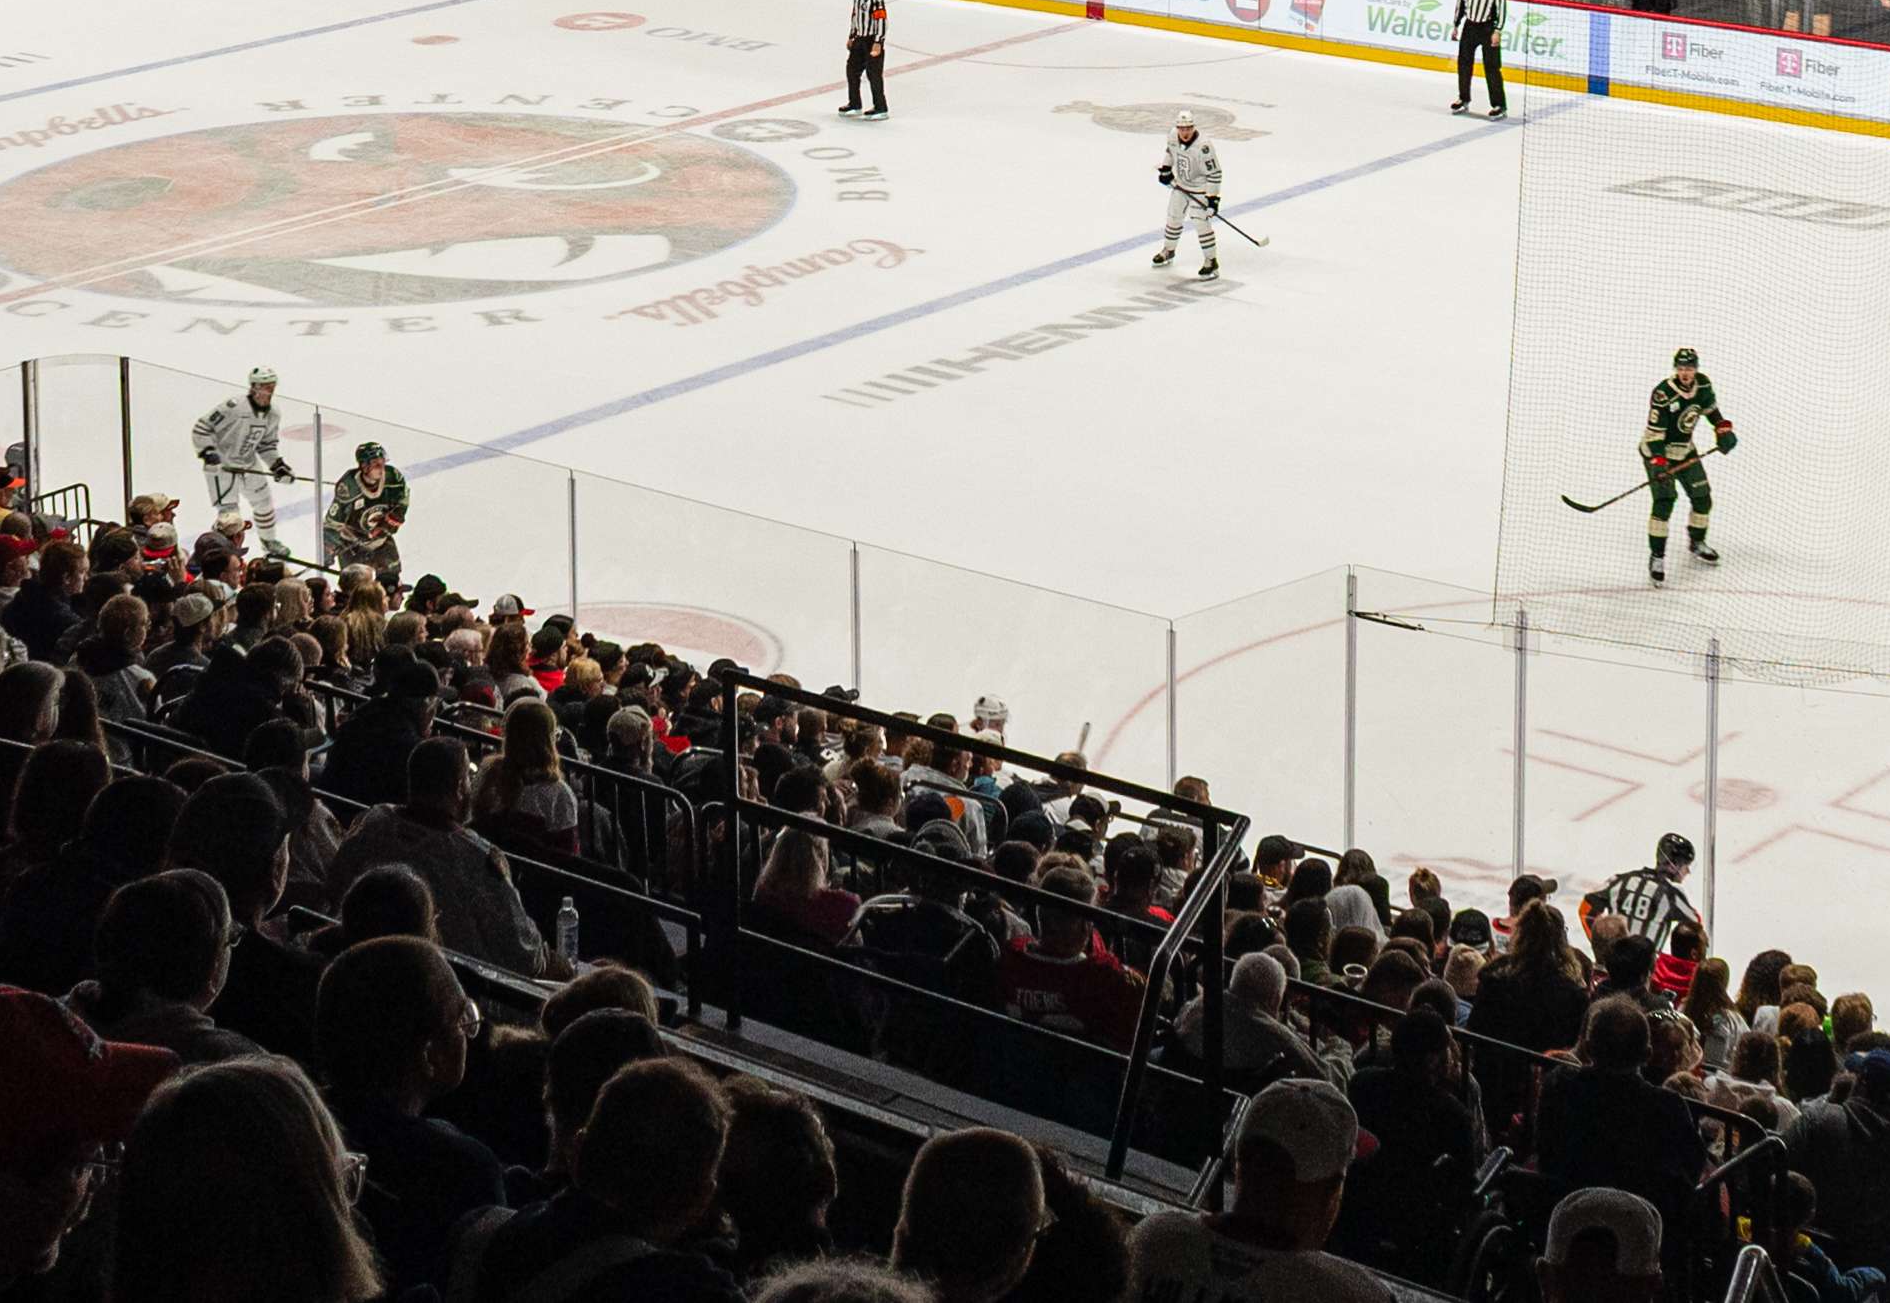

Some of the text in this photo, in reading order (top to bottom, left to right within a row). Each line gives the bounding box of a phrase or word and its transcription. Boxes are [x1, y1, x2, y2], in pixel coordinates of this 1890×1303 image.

[1367, 4, 1453, 42] Walter
[1689, 42, 1725, 60] Fiber
[1805, 58, 1841, 77] Fiber
[6, 299, 542, 338] CENTER
